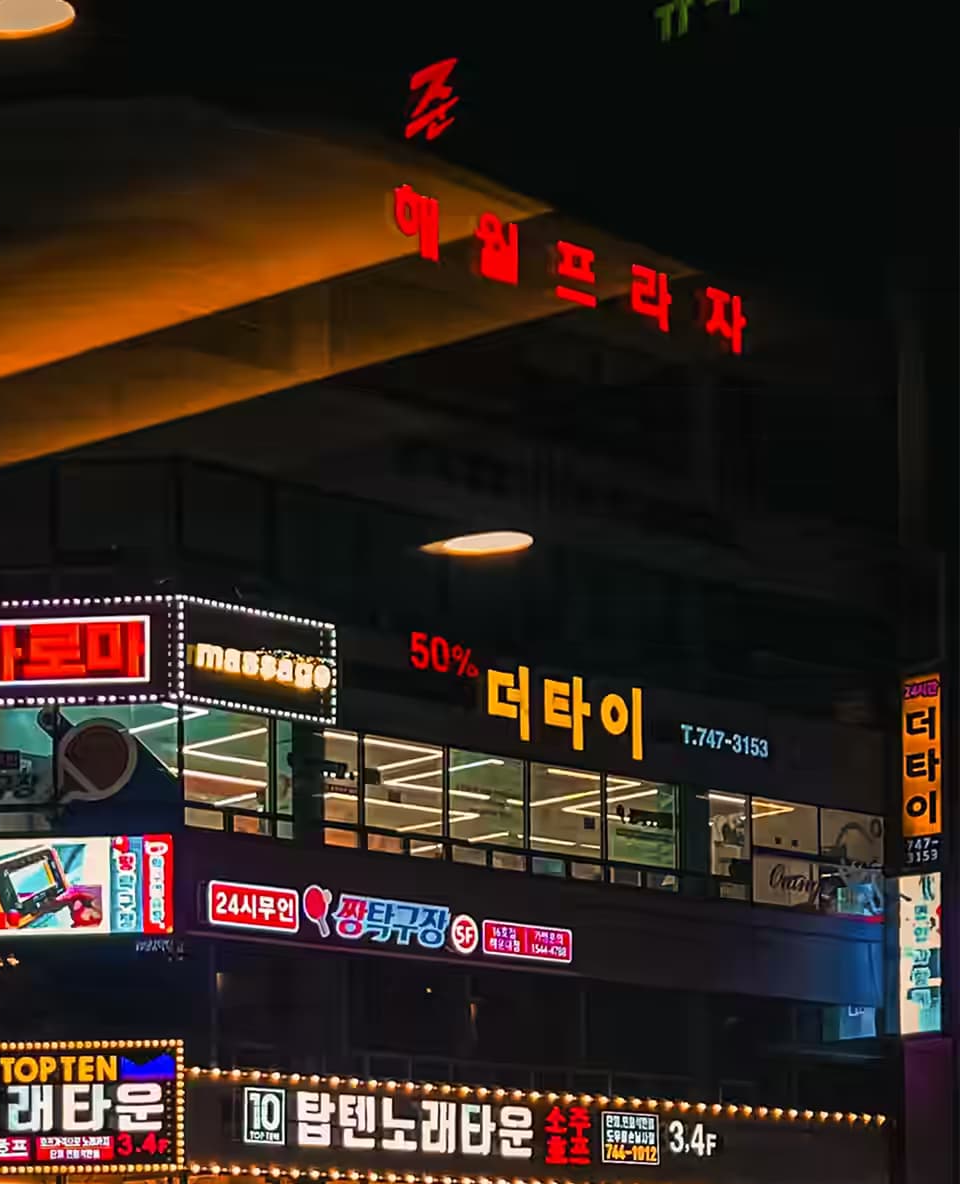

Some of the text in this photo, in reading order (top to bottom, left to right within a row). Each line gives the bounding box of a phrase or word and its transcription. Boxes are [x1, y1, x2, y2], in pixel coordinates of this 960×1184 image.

[410, 632, 479, 678] 50%
[488, 666, 642, 760] 더타이
[680, 724, 768, 758] T.747-3153
[906, 706, 939, 824] 더타이
[215, 893, 295, 923] 24시무인
[334, 893, 450, 949] 짱탁구장
[0, 1056, 57, 1083] TOP
[61, 1055, 118, 1082] TEN
[249, 1093, 280, 1131] 10
[296, 1091, 534, 1161] 탑텐노래타운
